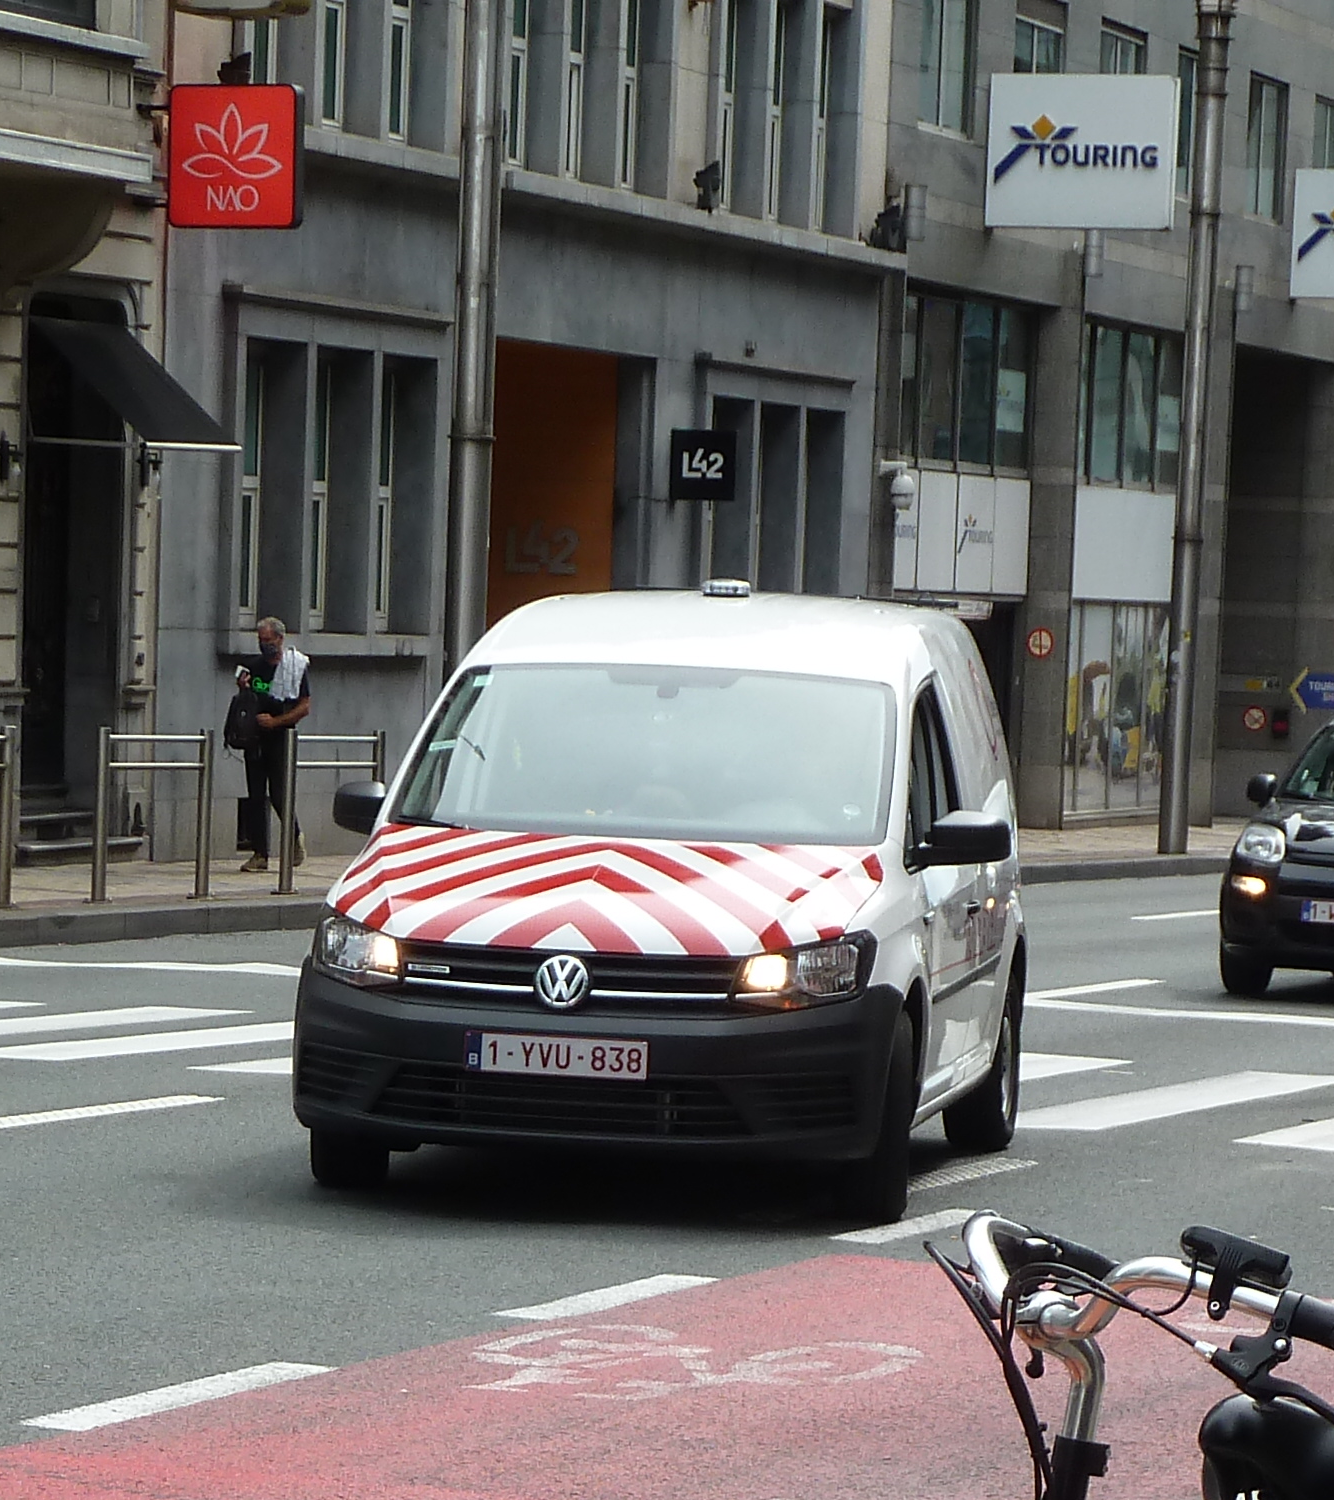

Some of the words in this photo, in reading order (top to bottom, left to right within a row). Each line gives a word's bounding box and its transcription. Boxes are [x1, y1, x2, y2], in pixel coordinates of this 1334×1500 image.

[1034, 143, 1159, 168] TOURING
[207, 185, 260, 211] NAO
[682, 448, 724, 479] L42
[505, 519, 580, 575] L42
[538, 957, 586, 1005] VW
[468, 1052, 478, 1065] B
[488, 1040, 643, 1073] 1-YVU-838
